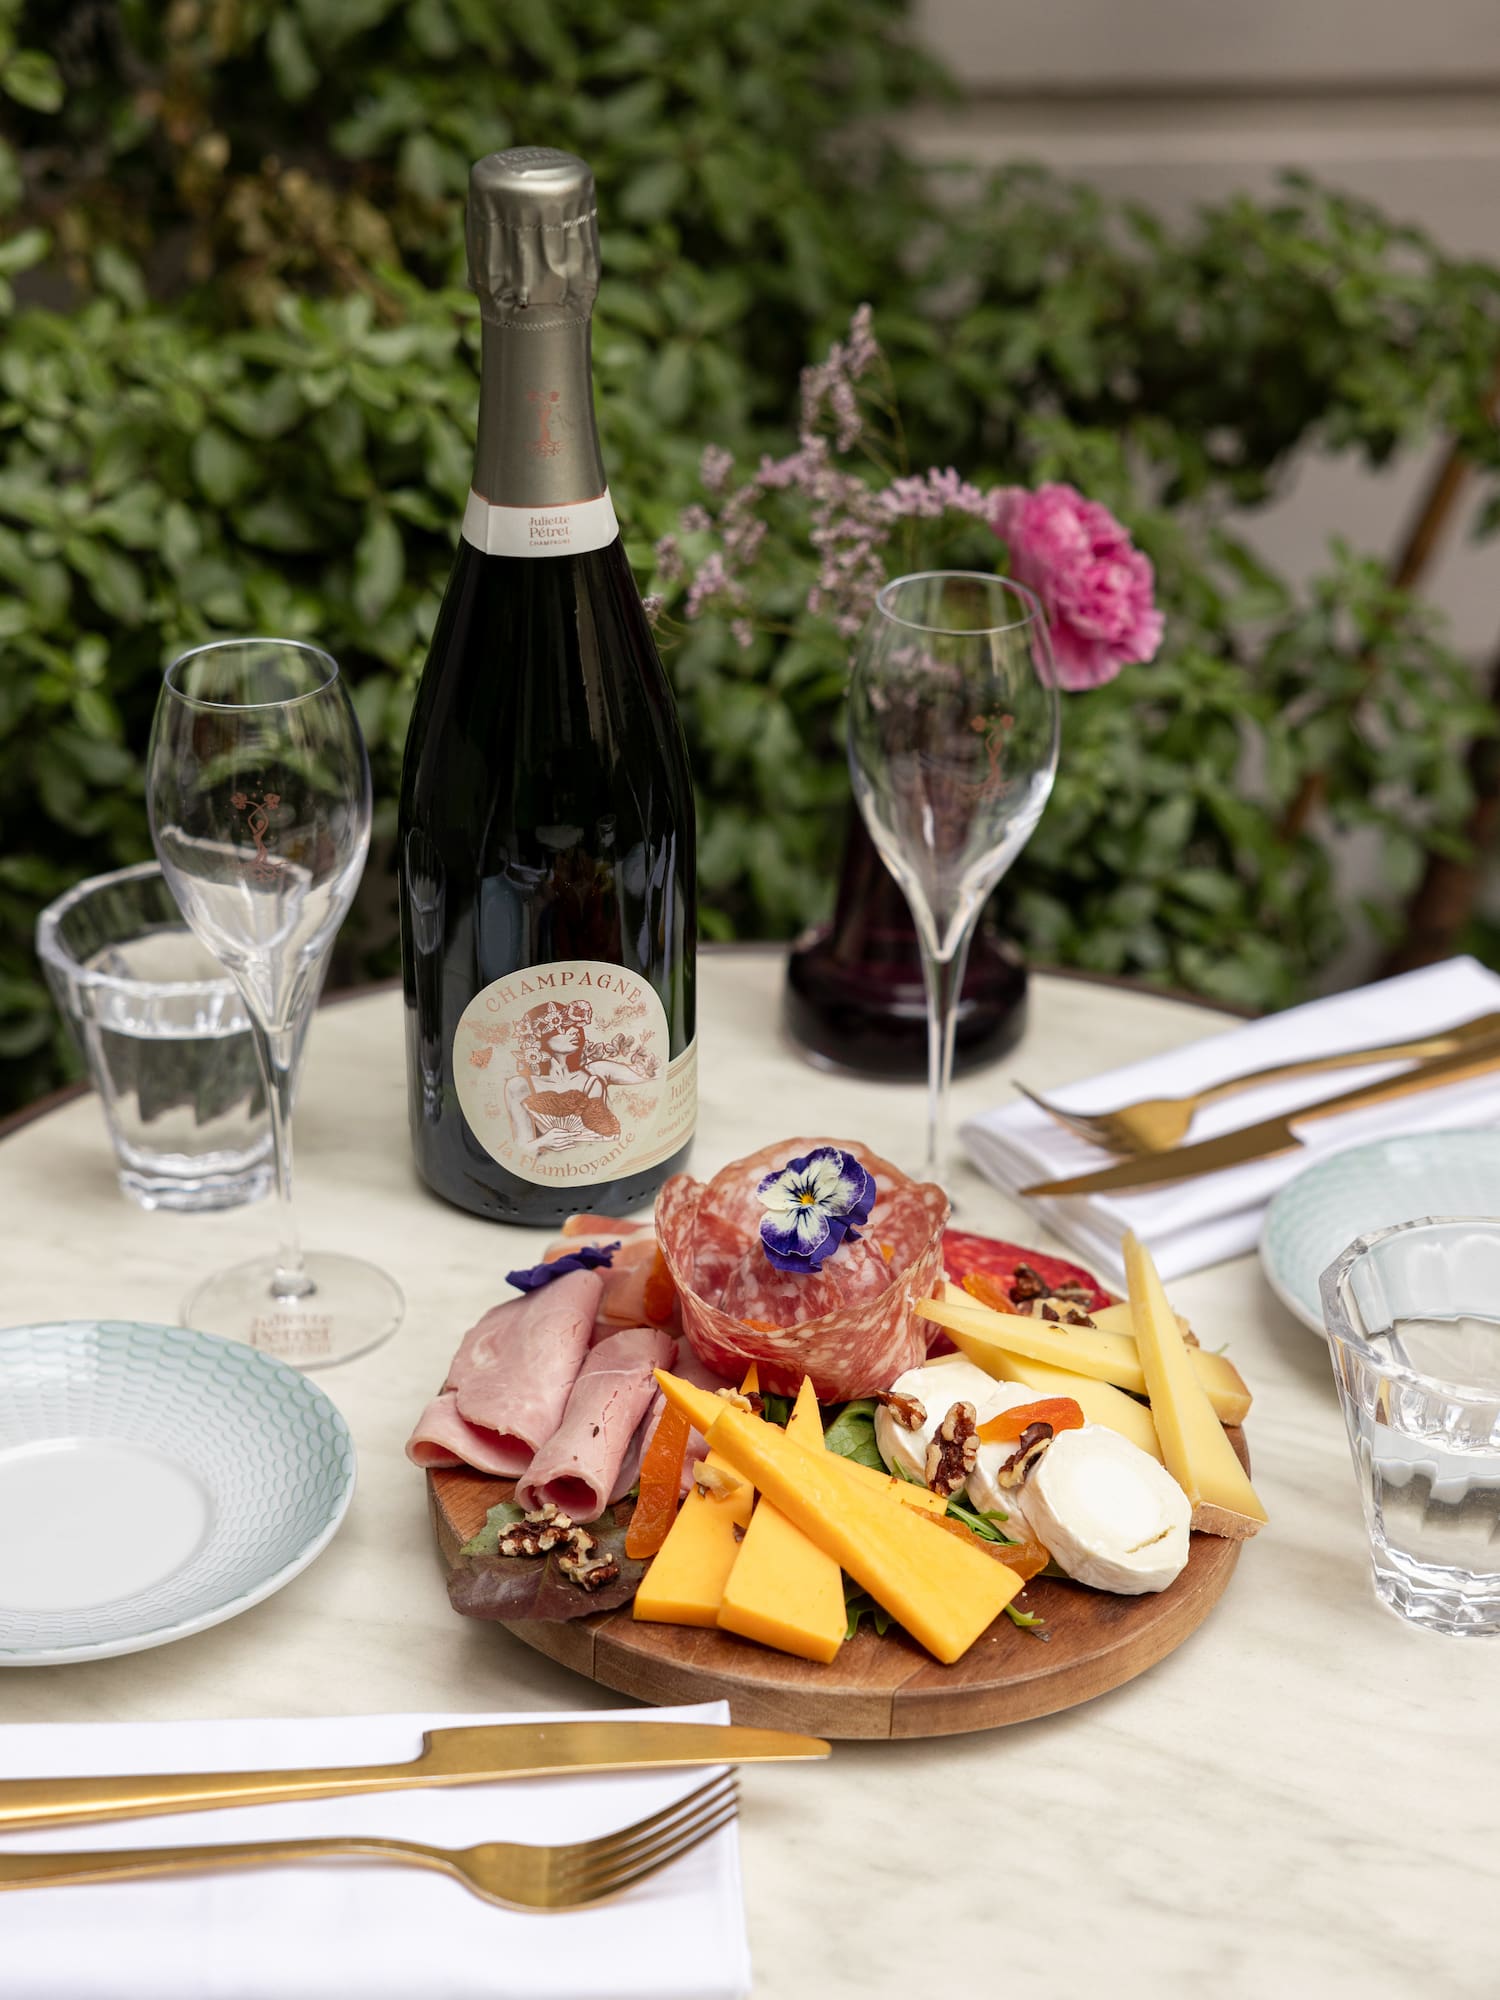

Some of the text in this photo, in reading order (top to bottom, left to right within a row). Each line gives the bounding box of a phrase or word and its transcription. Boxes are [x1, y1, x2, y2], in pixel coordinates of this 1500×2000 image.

[485, 971, 642, 1013] CHAMPAGNE
[497, 1131, 635, 1178] la Flamboyante
